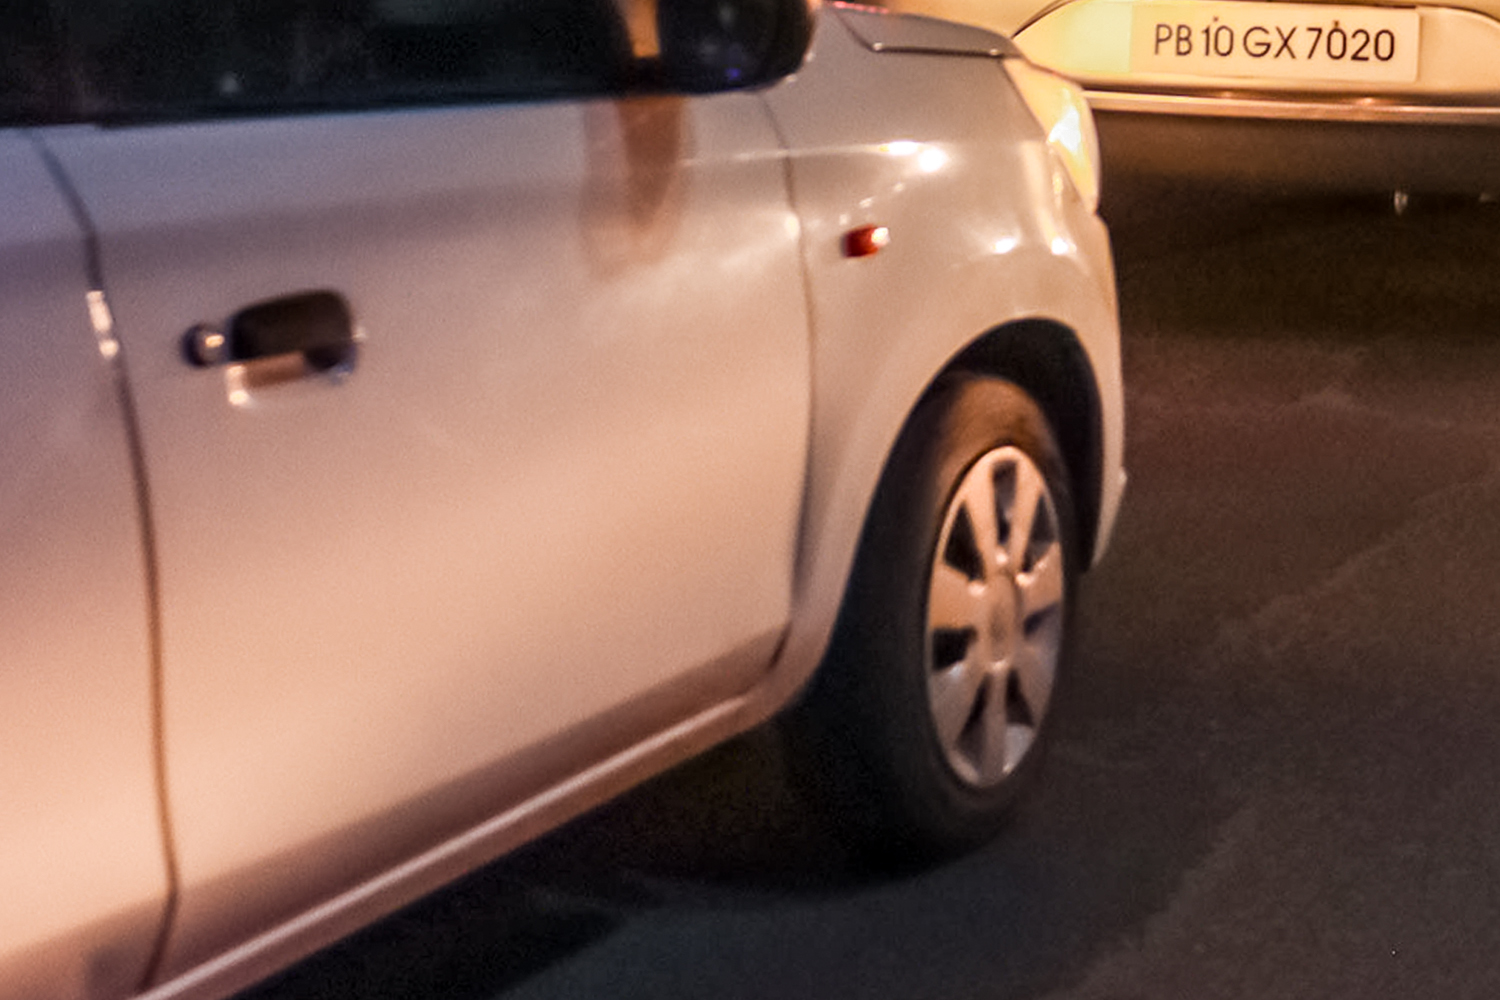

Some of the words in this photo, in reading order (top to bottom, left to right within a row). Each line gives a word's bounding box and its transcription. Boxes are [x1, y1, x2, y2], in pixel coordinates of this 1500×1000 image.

[1154, 24, 1193, 57] PB
[1202, 25, 1234, 58] 10
[1243, 26, 1296, 60] GX
[1306, 27, 1396, 62] 7020
